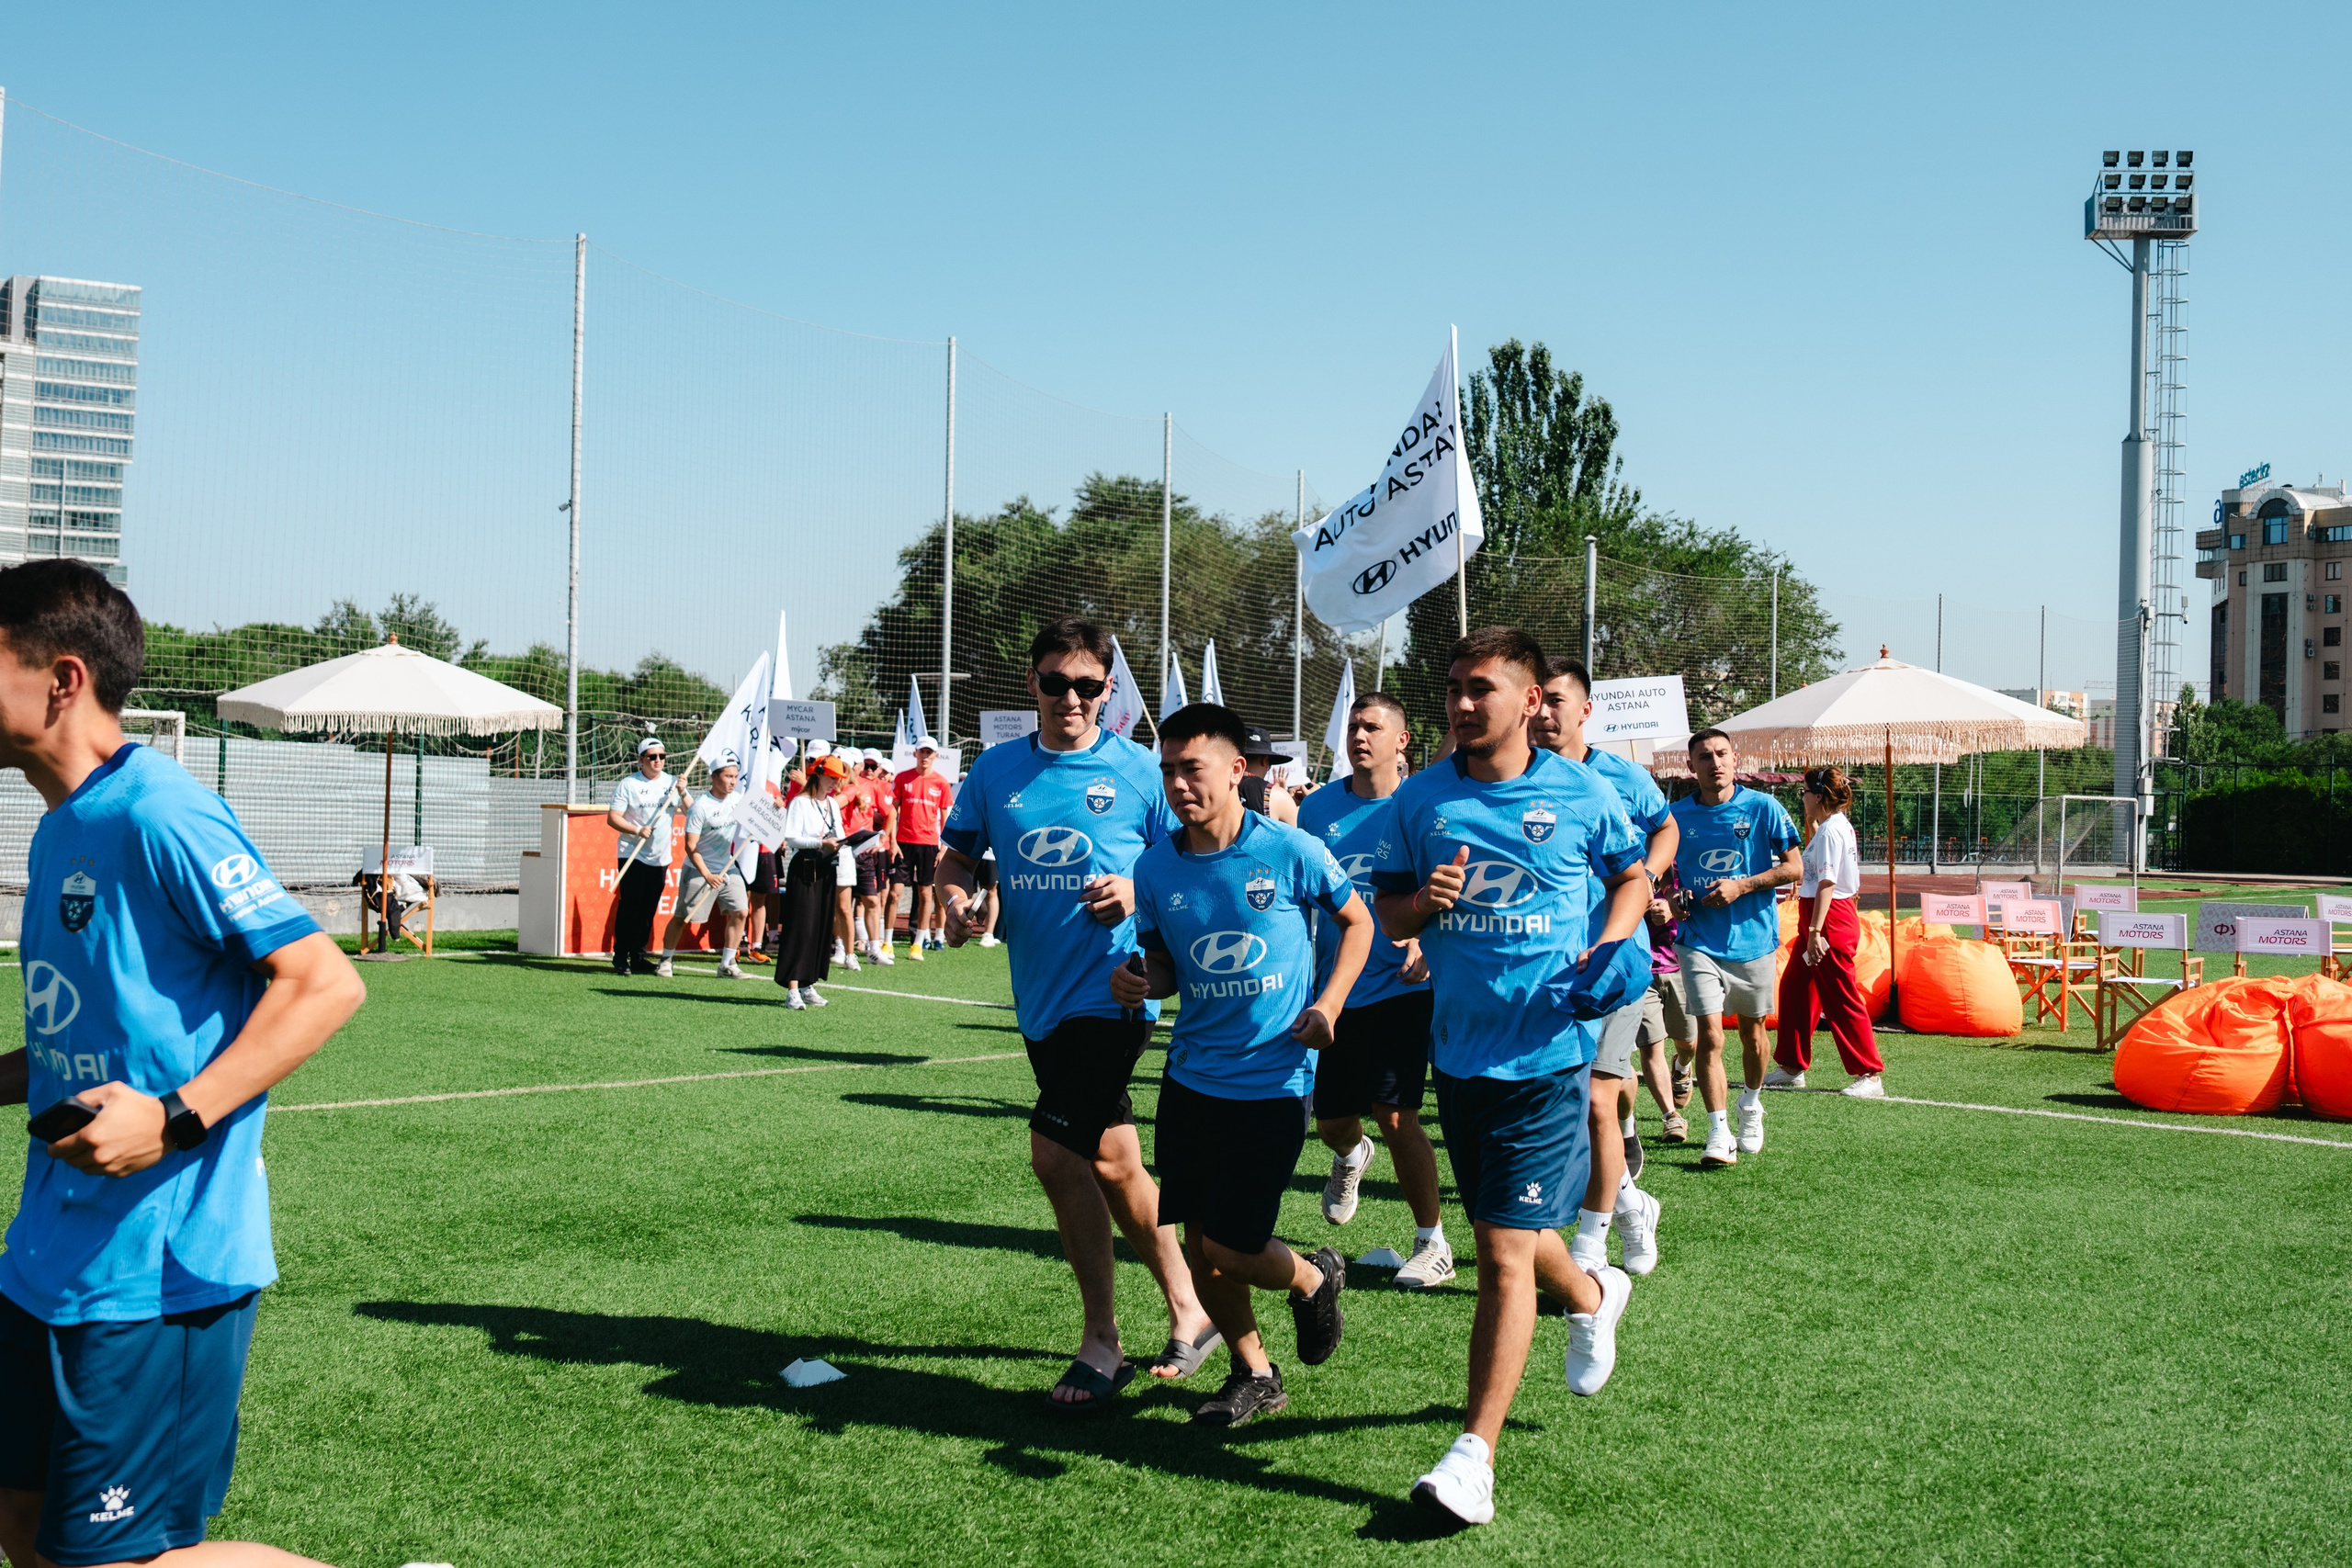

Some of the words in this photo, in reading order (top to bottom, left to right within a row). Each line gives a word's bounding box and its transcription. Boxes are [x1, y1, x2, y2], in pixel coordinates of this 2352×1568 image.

[1314, 496, 1375, 551] AUTO
[1387, 423, 1454, 502] ASTA
[1398, 511, 1458, 565] HYUN
[1638, 687, 1667, 698] AUTO
[786, 705, 814, 714] MYCAR
[1607, 700, 1650, 712] ASTANA
[786, 714, 817, 723] ASTANA
[1621, 721, 1659, 731] HYUNDAI
[759, 796, 785, 821] HYUNDAI
[748, 800, 782, 834] KARAGANDA
[1011, 874, 1103, 890] HYUNDA
[1168, 904, 1189, 912] KELME
[2328, 908, 2352, 917] MOTORS
[1936, 909, 1971, 918] MOTORS
[1439, 912, 1551, 933] HYUNDAI
[2016, 915, 2047, 923] MOTORS
[2119, 930, 2165, 940] MOTORS
[2273, 929, 2308, 937] ASTANA
[2258, 935, 2307, 945] MOTORS
[1190, 972, 1283, 999] HYUNDAI
[1519, 1195, 1544, 1205] KELME
[89, 1506, 135, 1523] KELME
